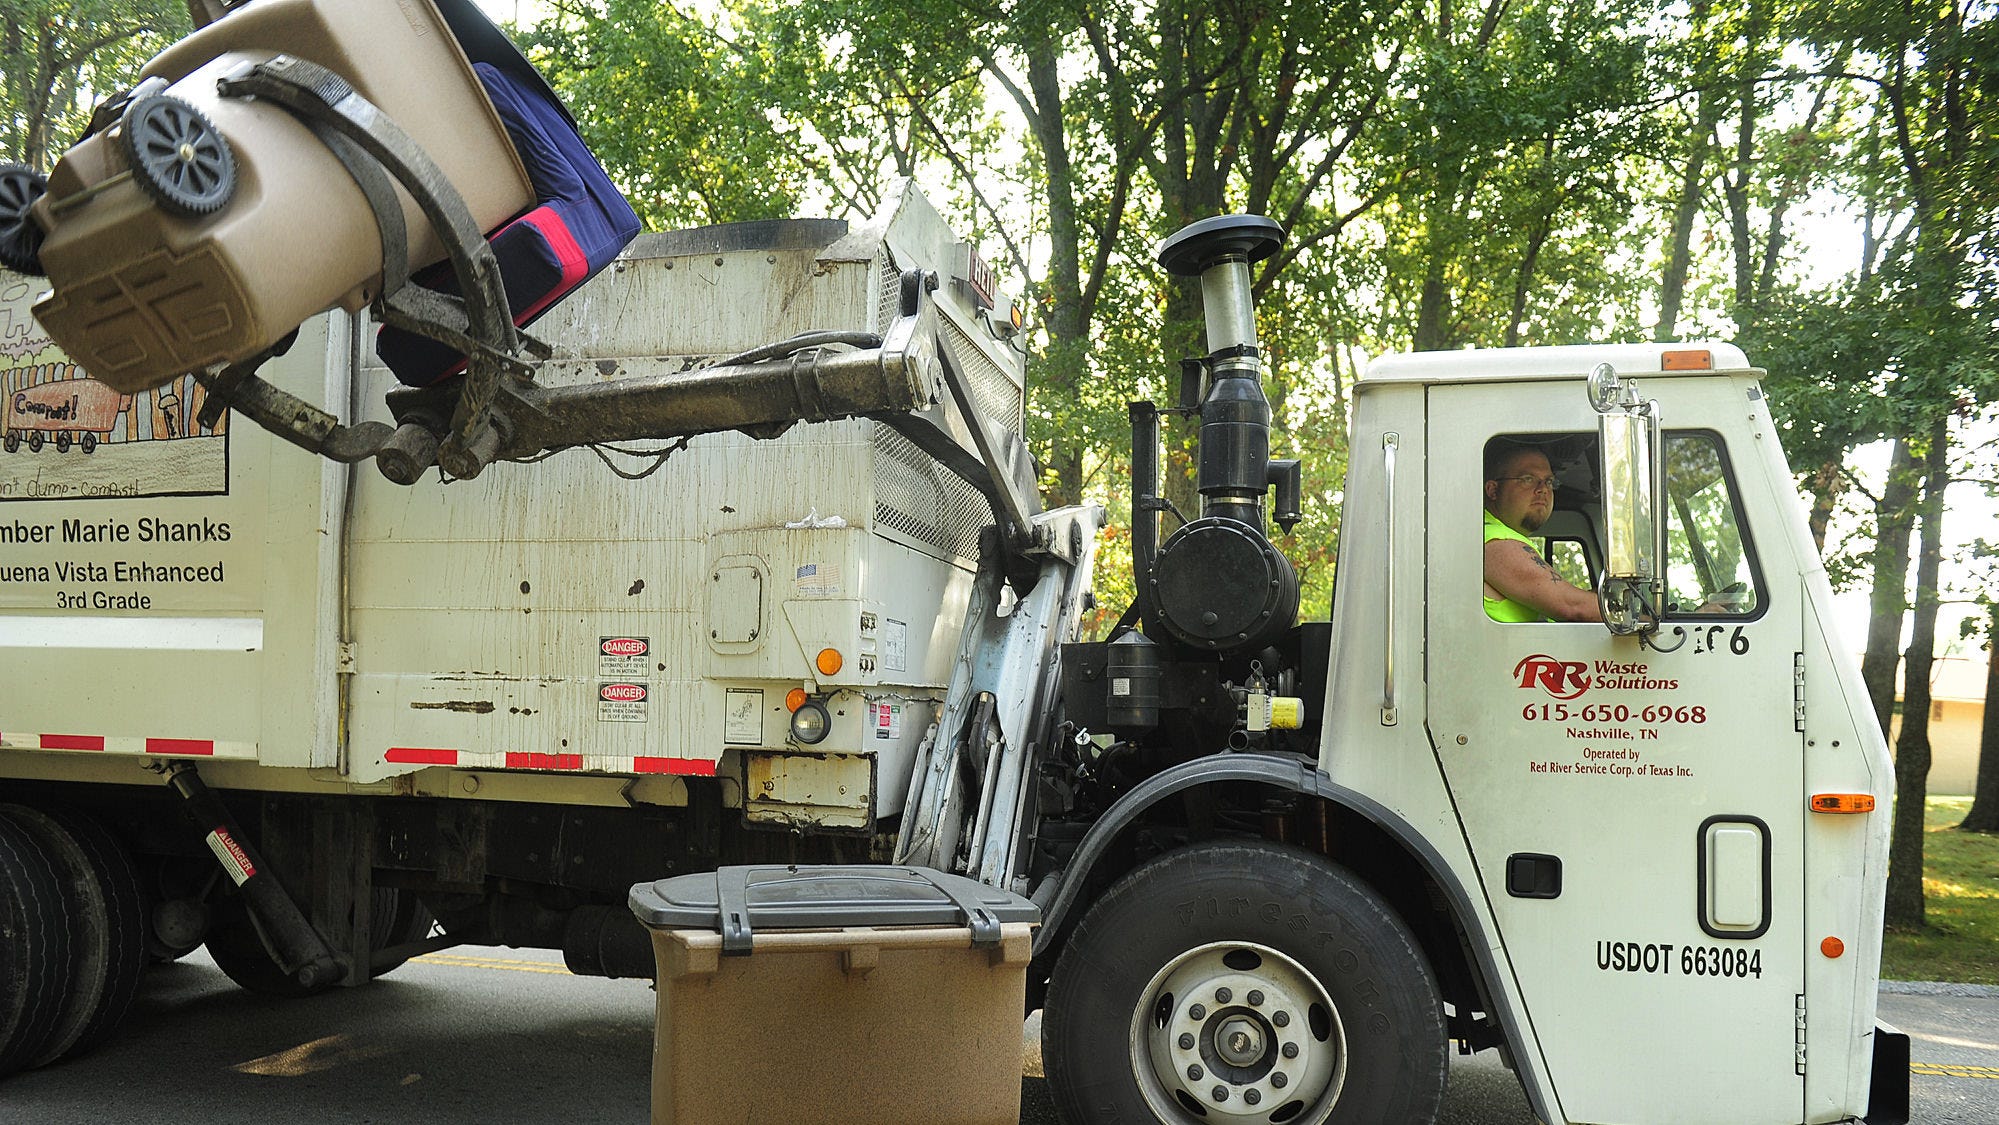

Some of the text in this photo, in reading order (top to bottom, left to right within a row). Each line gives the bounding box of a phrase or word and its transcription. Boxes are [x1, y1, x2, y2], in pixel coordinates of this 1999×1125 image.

[62, 518, 130, 543] Marie
[138, 517, 231, 542] Shanks
[55, 561, 108, 582] Vista
[114, 561, 224, 582] Enhanced
[56, 591, 151, 610] 3rd Grade
[605, 641, 644, 652] DANGER
[1595, 660, 1648, 675] Waste
[1595, 675, 1679, 691] Solutions
[604, 687, 642, 698] DANGER
[1522, 703, 1707, 724] 615-650-6968
[1566, 728, 1658, 741] Nashville, TN
[1583, 748, 1640, 762] Operated by
[1530, 762, 1694, 778] Red River Service Corp. of Texas Inc.
[224, 837, 253, 871] DANGER
[1597, 940, 1762, 979] USDOT 663084
